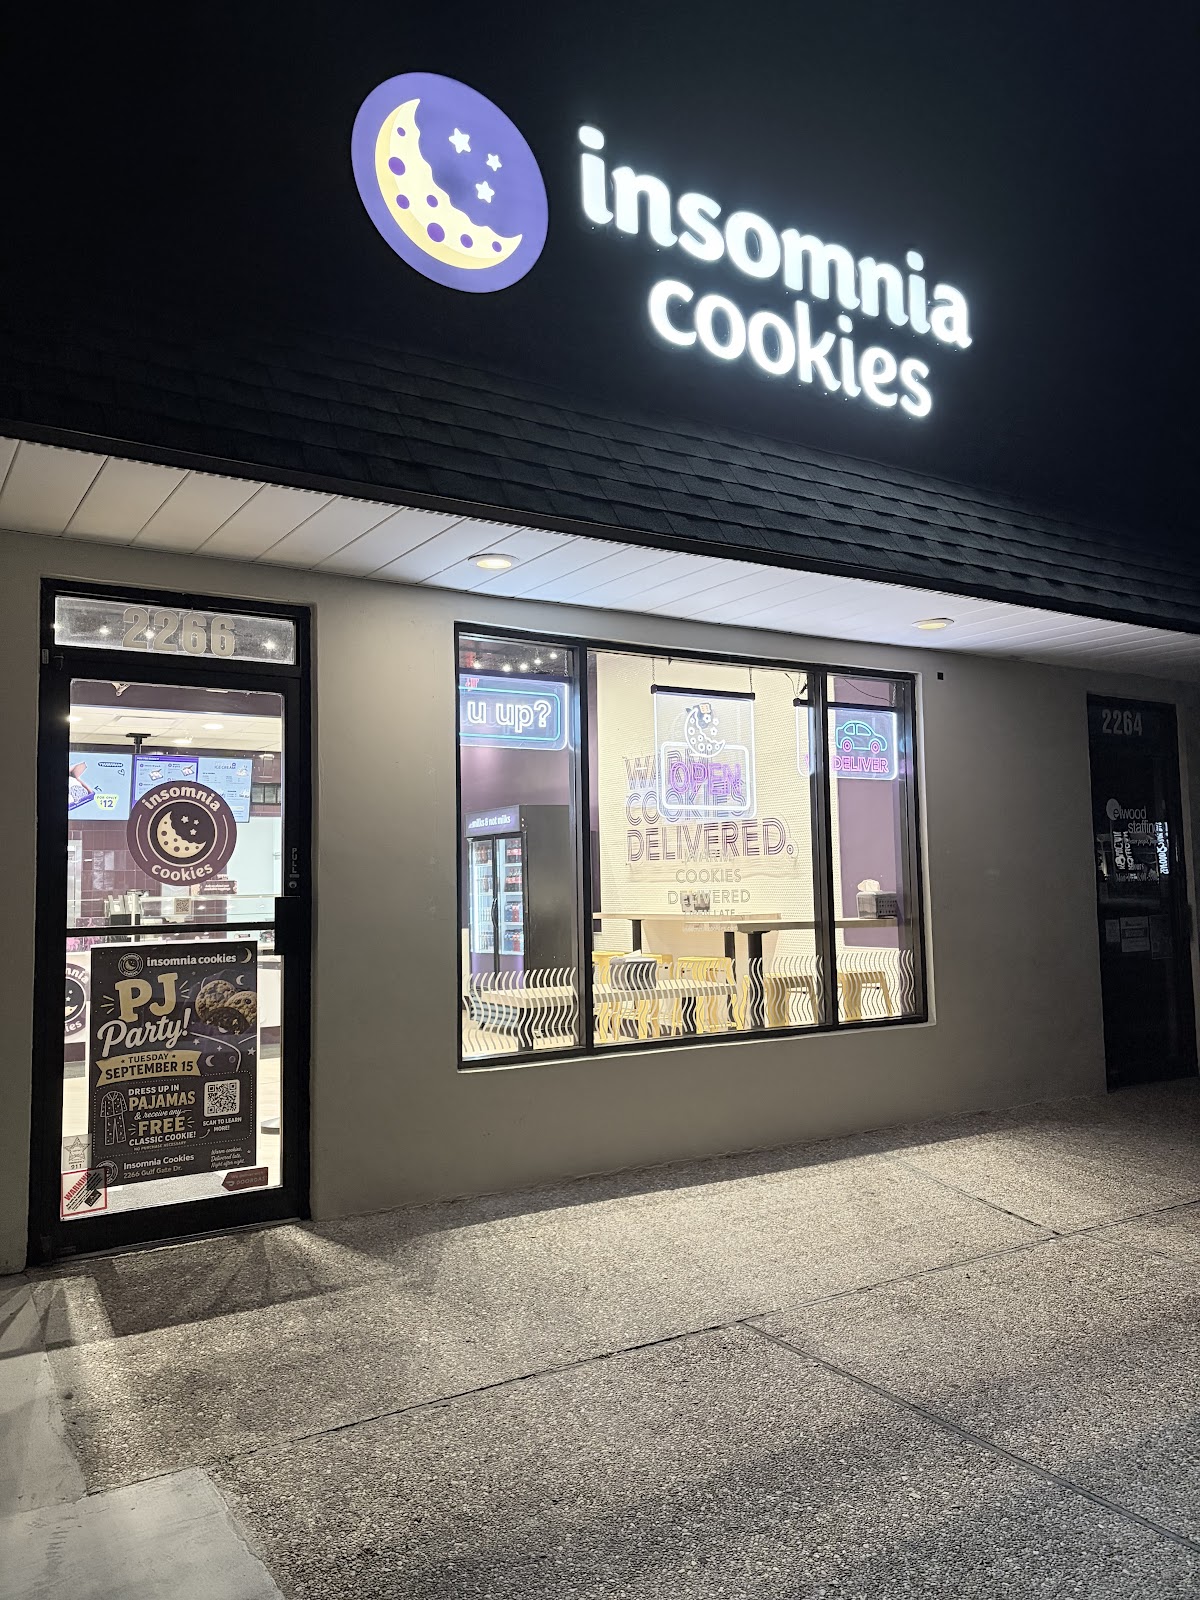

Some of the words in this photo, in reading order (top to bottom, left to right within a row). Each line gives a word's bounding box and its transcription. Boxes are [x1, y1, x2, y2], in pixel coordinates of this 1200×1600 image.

[578, 124, 973, 349] insomnia
[648, 278, 933, 418] cookies
[122, 606, 236, 657] 2266
[467, 701, 487, 724] u
[495, 699, 552, 733] up?
[1102, 709, 1143, 736] 2264
[832, 755, 889, 773] DELIVER
[669, 761, 743, 796] OPEN
[142, 786, 221, 812] insomnia
[1113, 805, 1147, 820] elwood
[151, 862, 214, 881] cookies
[675, 868, 742, 883] COOKIES
[147, 955, 197, 967] insomnia
[198, 954, 237, 965] cookies
[115, 973, 178, 1023] PJ
[97, 1008, 192, 1057] Party!
[128, 1053, 169, 1064] TUESDAY
[105, 1061, 178, 1080] SEPTEMBER
[181, 1061, 194, 1072] 15
[128, 1087, 157, 1096] DRESS
[158, 1085, 171, 1093] UP
[171, 1084, 180, 1092] IN
[128, 1091, 196, 1112] PAJAMAS
[134, 1111, 142, 1120] &
[143, 1110, 168, 1119] receive
[169, 1108, 187, 1118] any
[202, 1119, 217, 1127] SCAN
[138, 1117, 186, 1136] FREE
[129, 1135, 164, 1147] CLASSIC
[165, 1131, 196, 1142] COOKIE!
[123, 1158, 161, 1170] Insomnia
[163, 1154, 195, 1164] Cookies
[123, 1171, 140, 1179] 2266
[141, 1168, 156, 1176] Gulf
[236, 1177, 266, 1186] DOORDAS
[64, 1171, 92, 1201] WARNING
